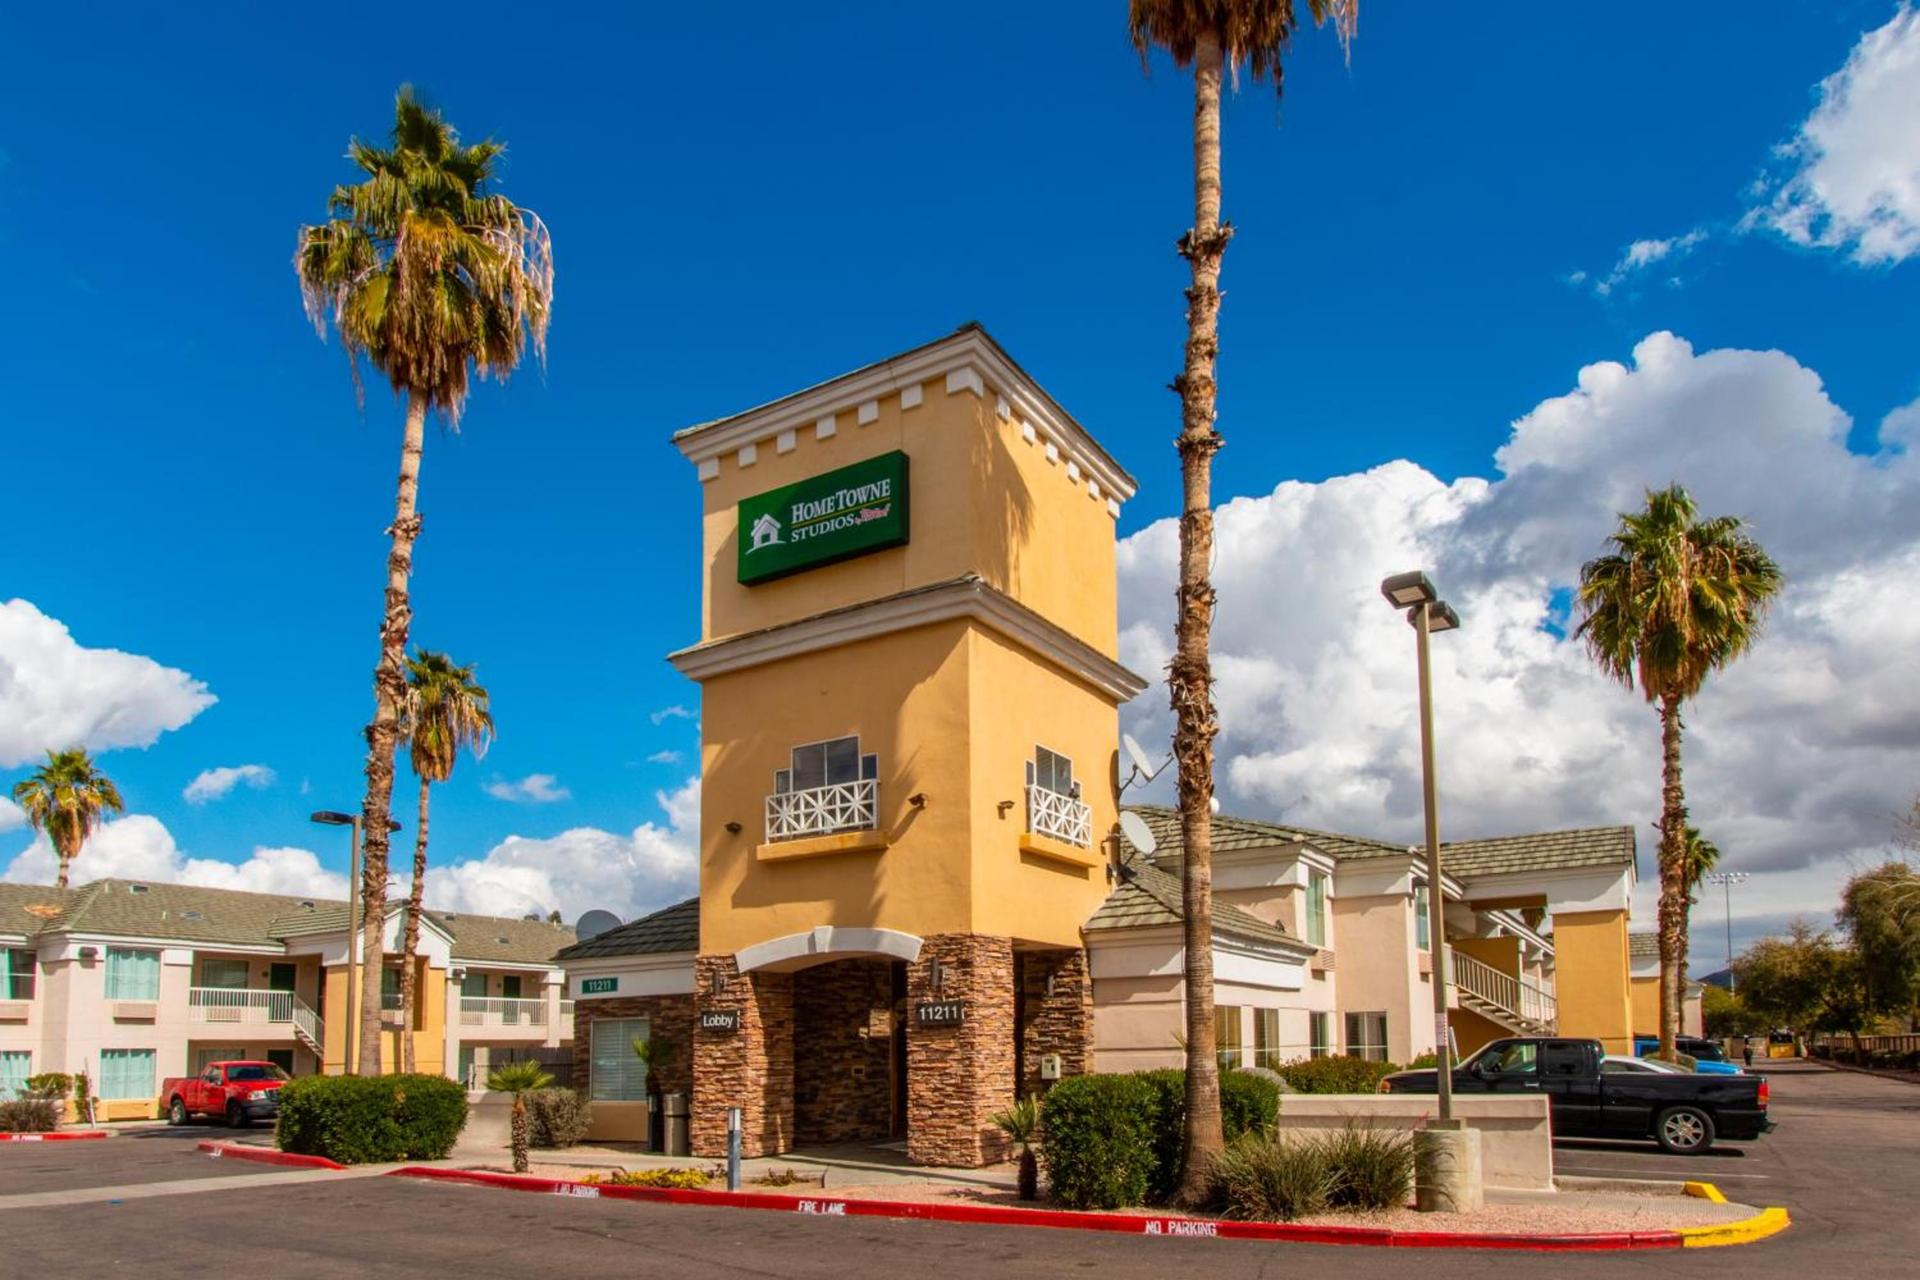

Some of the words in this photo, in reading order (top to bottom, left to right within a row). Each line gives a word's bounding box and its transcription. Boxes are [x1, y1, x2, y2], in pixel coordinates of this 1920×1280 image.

[791, 513, 855, 543] STUDIOS
[588, 980, 611, 991] 11211
[920, 1006, 957, 1020] 11211
[703, 1014, 734, 1029] Lobby
[798, 1200, 818, 1214] FIRE
[821, 1202, 846, 1216] LANE
[1145, 1220, 1162, 1235] NO
[1168, 1221, 1217, 1237] PARKING
